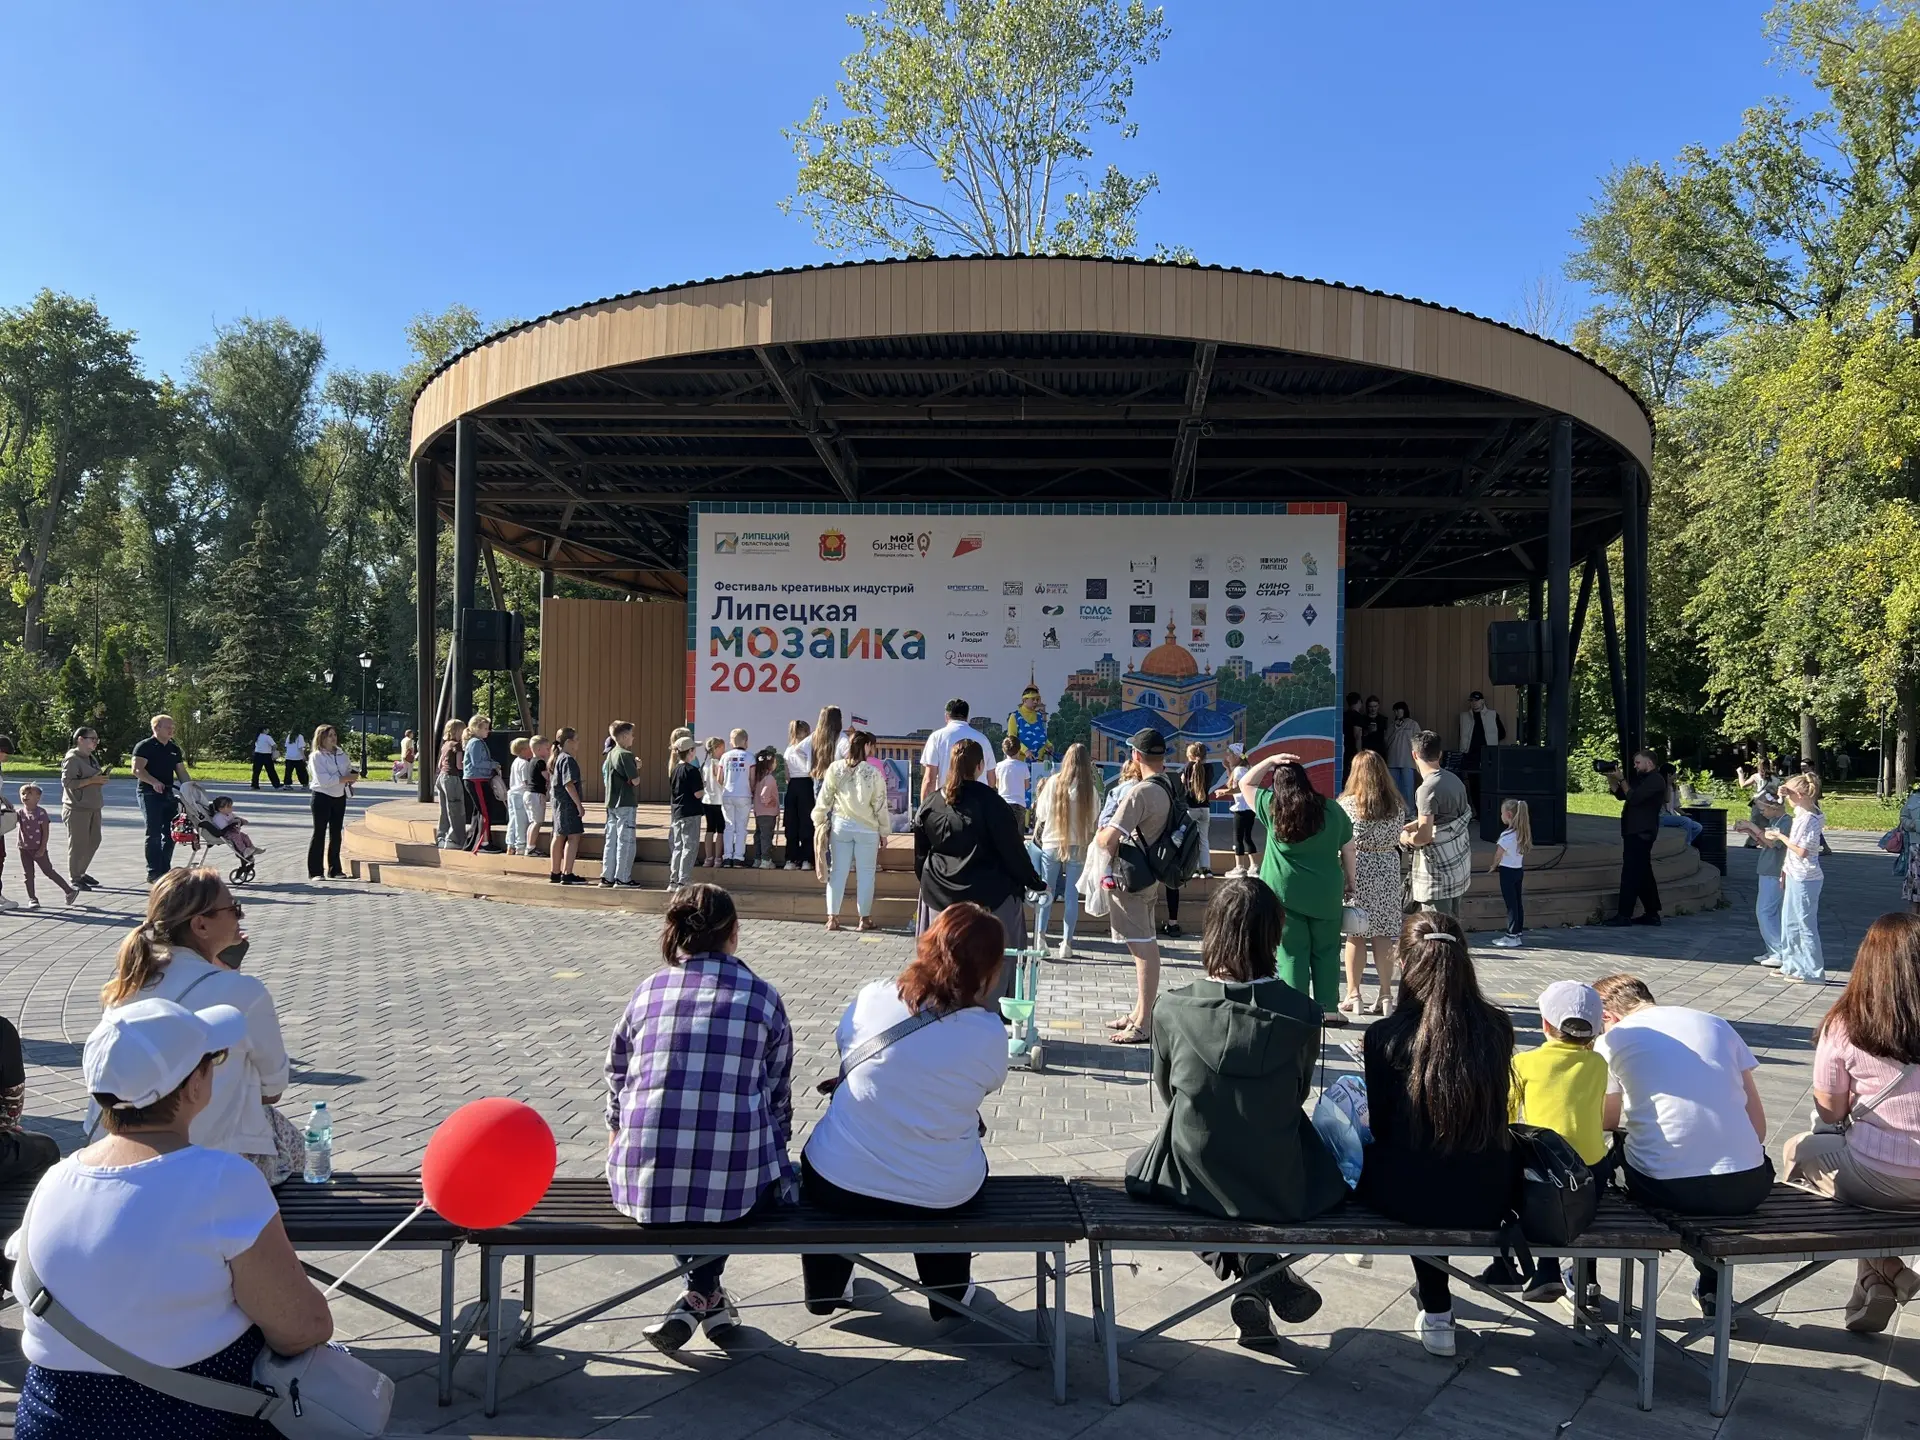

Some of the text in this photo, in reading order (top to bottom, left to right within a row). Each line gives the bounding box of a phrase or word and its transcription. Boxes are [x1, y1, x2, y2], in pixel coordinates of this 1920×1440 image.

[741, 531, 790, 541] ЛИПЕЦКИЙ
[872, 539, 914, 551] бизнес
[714, 581, 915, 595] Фестиваль креативных индустрий
[1258, 582, 1290, 590] КИНО
[1256, 589, 1291, 597] СТАРТ
[711, 595, 857, 625] Липецкая
[710, 662, 801, 693] 2026
